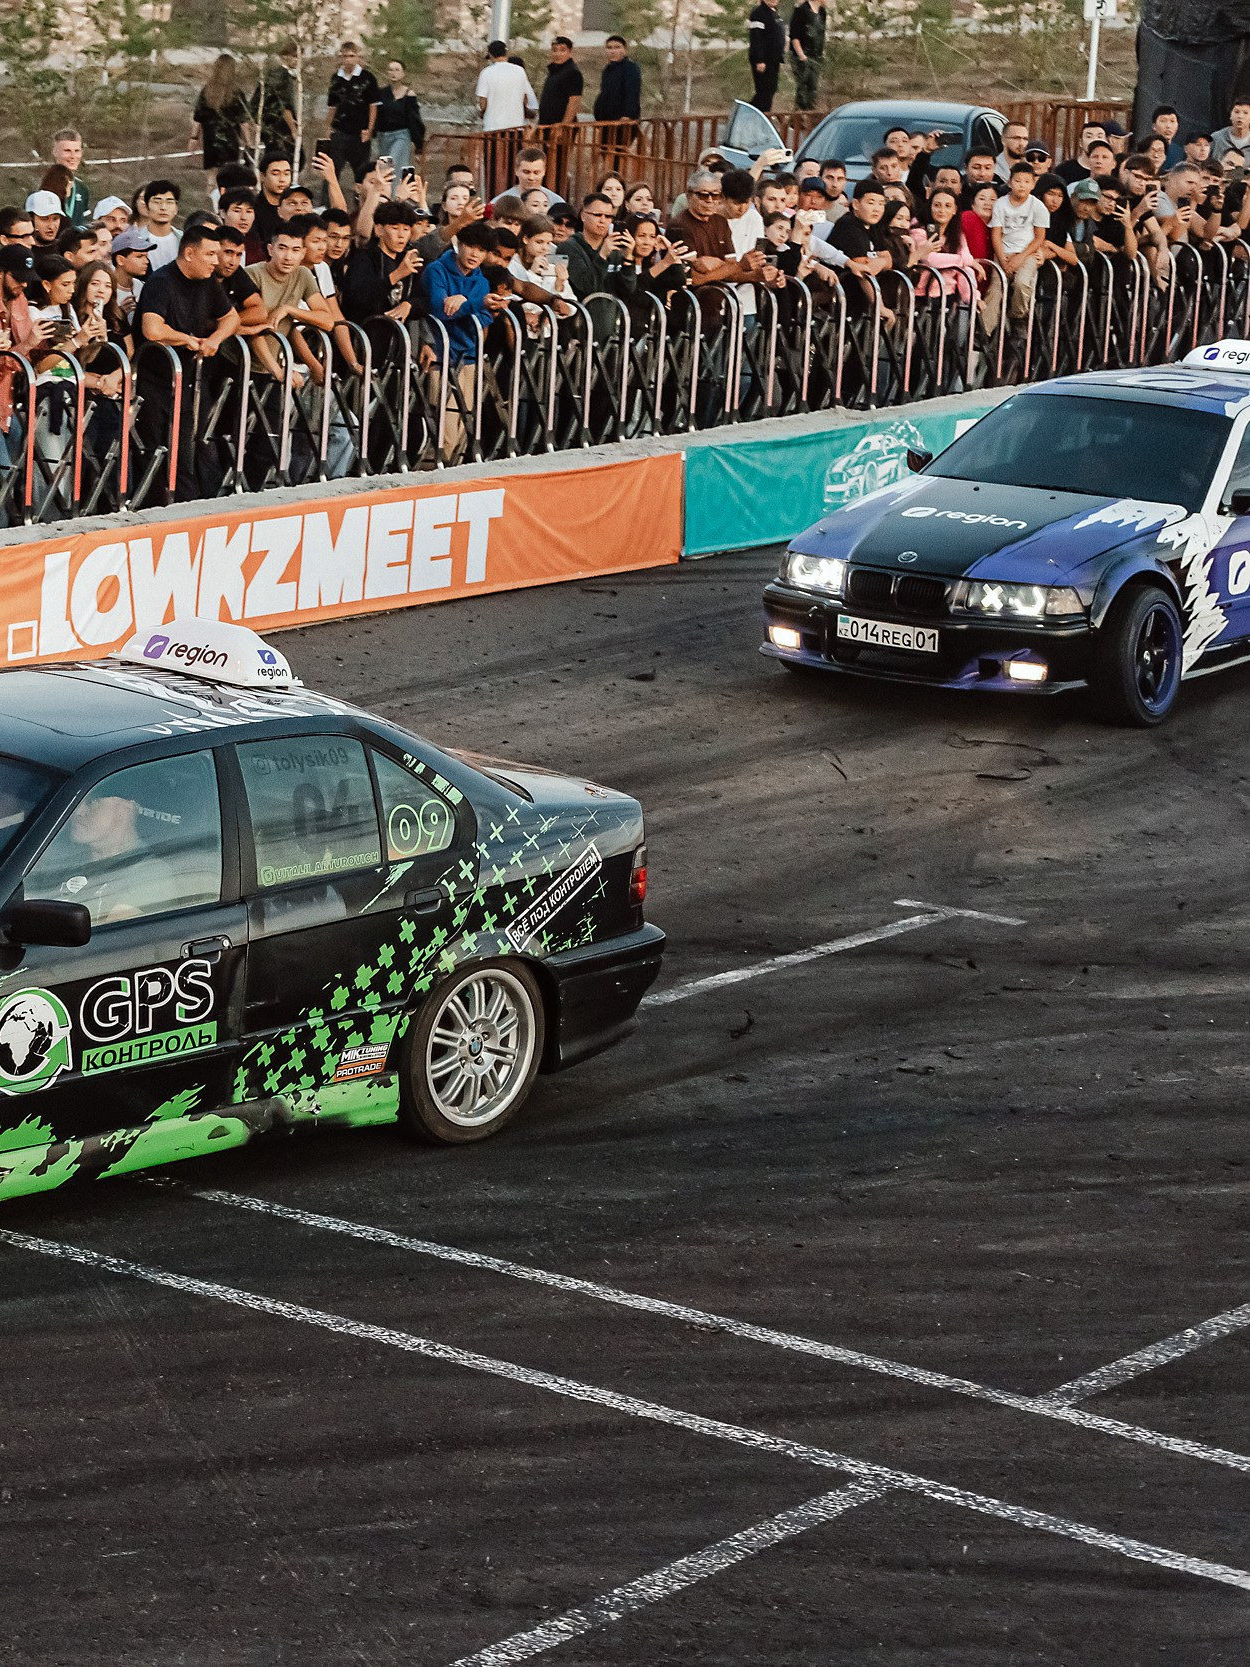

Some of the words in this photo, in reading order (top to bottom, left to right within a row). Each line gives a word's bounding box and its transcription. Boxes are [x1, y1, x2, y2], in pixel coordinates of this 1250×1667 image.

[935, 511, 1028, 529] region
[839, 628, 849, 637] KZ
[166, 643, 229, 667] region
[257, 666, 288, 679] region
[273, 747, 349, 774] tolysik09
[388, 799, 449, 855] 09
[511, 917, 531, 943] ВСЁ
[530, 901, 550, 926] ПОД
[549, 852, 598, 907] КОНТРОЛЕМ
[79, 959, 215, 1042] GPS
[85, 1029, 212, 1072] КОНТРОЛЬ
[336, 1062, 382, 1077] PROTRADE
